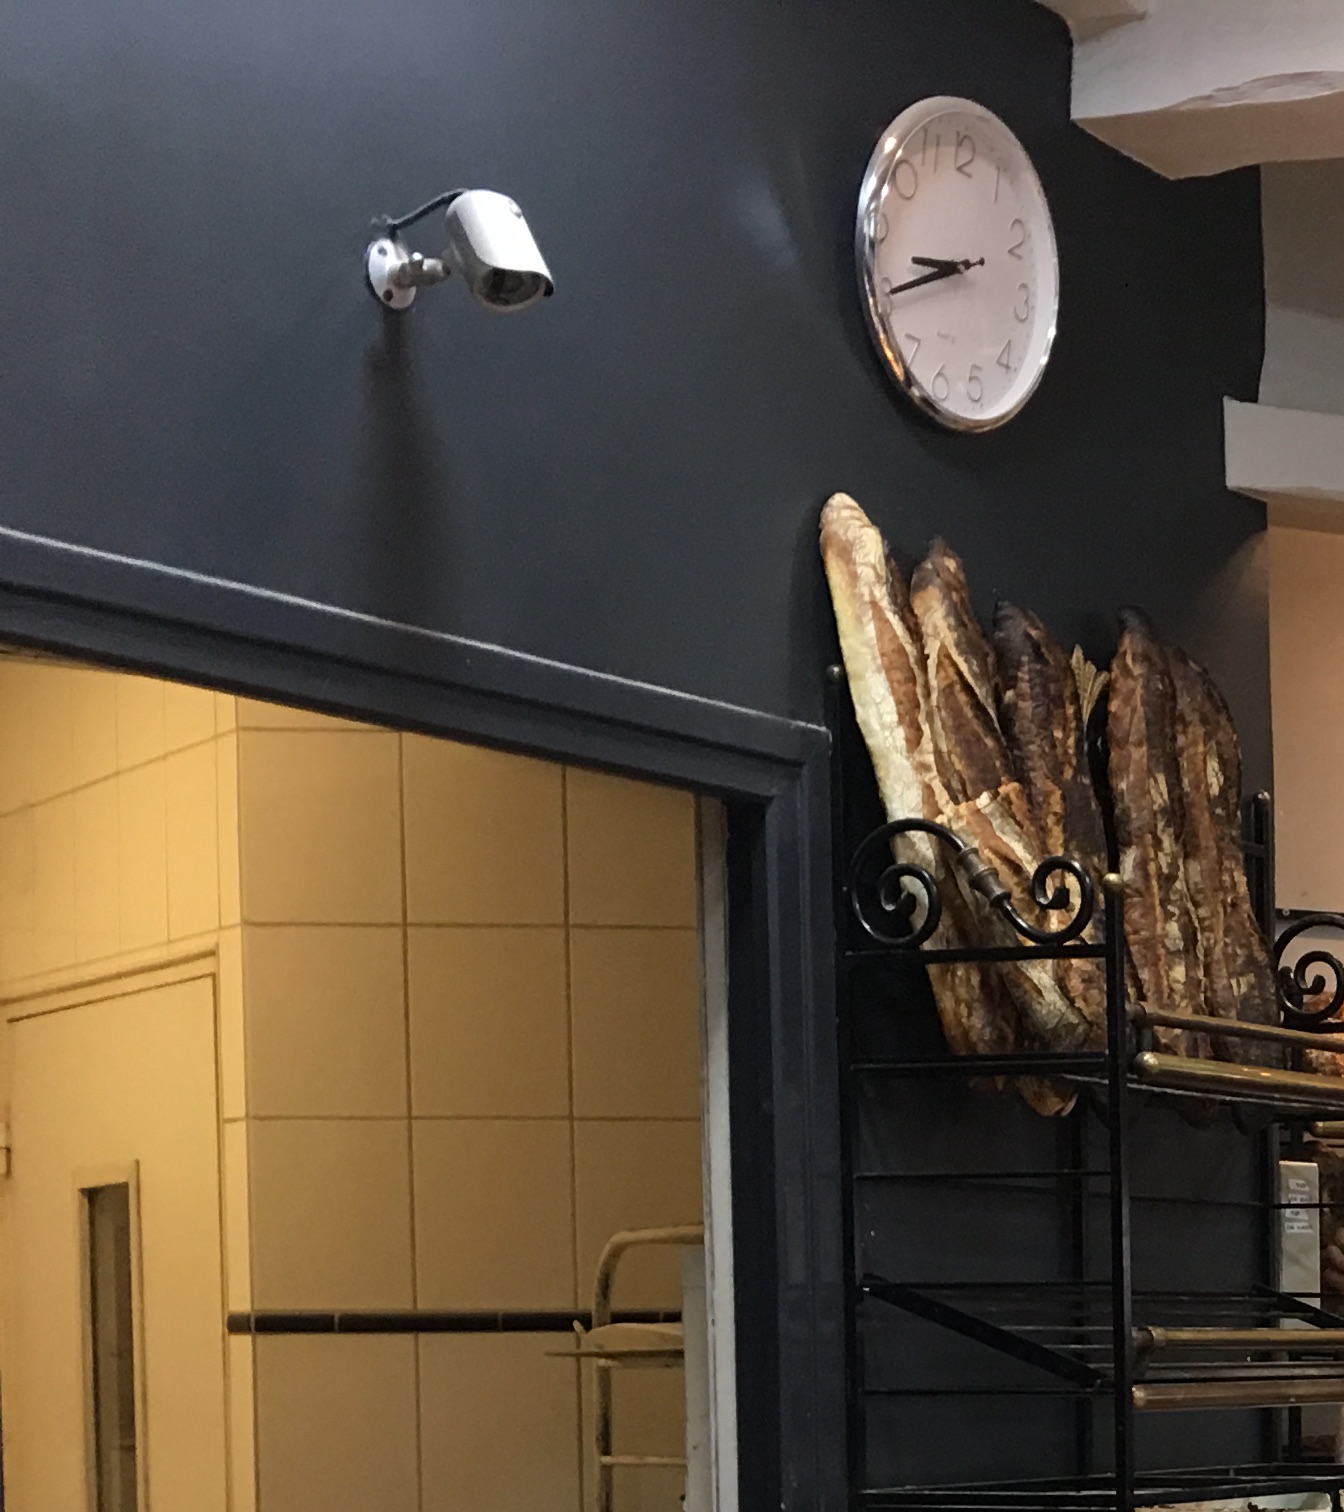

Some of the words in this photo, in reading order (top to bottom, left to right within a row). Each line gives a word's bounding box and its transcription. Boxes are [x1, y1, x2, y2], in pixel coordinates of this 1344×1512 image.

[921, 127, 941, 174] 11
[954, 130, 977, 179] 12
[893, 158, 918, 200] 0
[1007, 218, 1027, 260] 2
[1013, 281, 1031, 323] 3
[903, 332, 922, 366] 7
[995, 338, 1018, 373] 4
[931, 363, 949, 401] 6
[965, 363, 984, 402] 5
